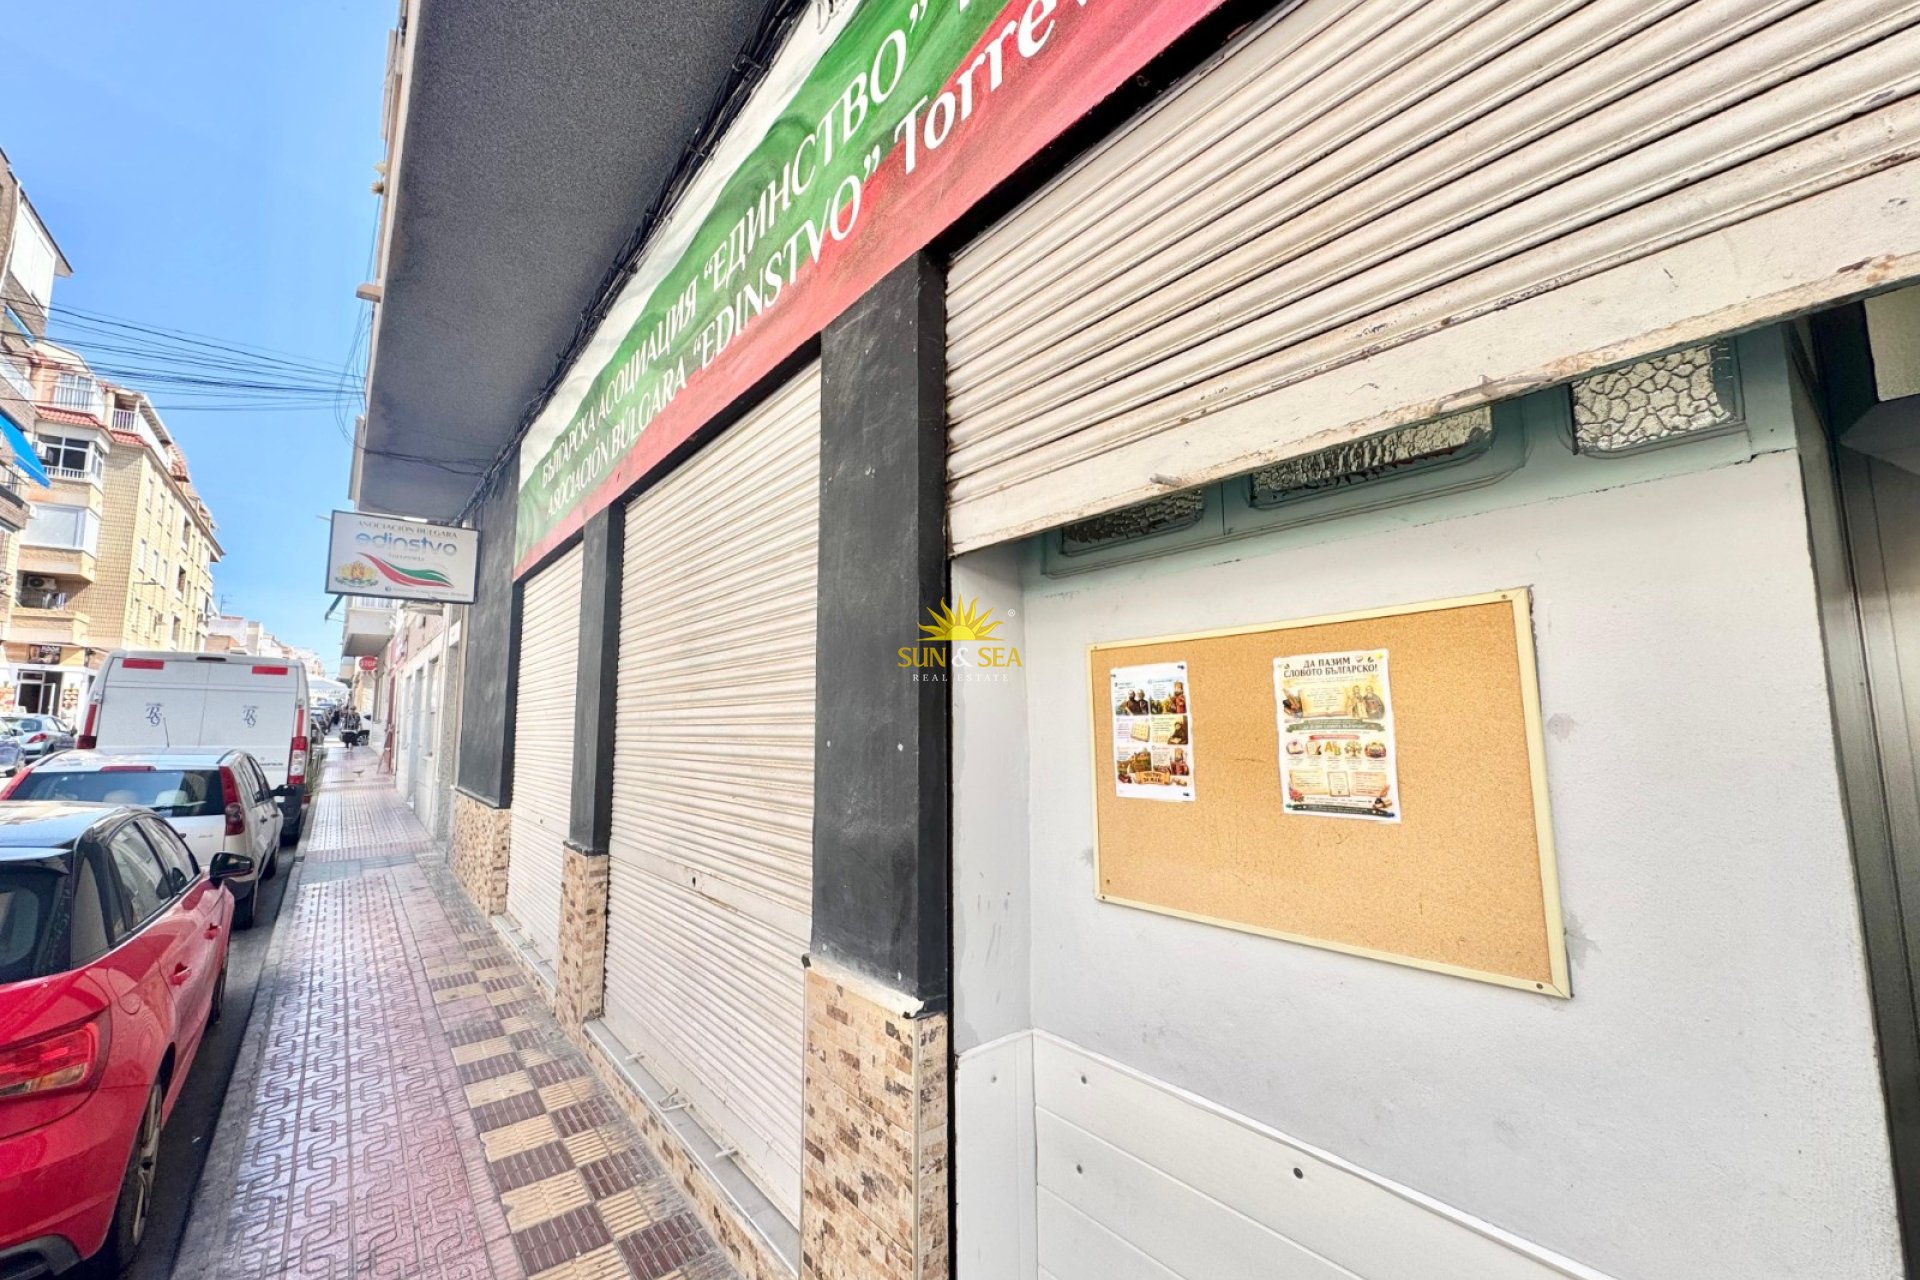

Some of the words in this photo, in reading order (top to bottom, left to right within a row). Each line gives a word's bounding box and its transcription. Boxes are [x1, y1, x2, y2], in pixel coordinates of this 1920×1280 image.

[546, 430, 610, 520] ASOCIACIÓN
[894, 0, 1087, 175] Torre
[542, 413, 596, 488] БЪЛГАРСКА
[595, 275, 700, 430] АСОЦИАЦИЯ
[356, 532, 457, 556] edinstvo
[1284, 668, 1323, 678] СЛОВОТО
[1303, 659, 1316, 669] ДА
[1318, 657, 1351, 667] ПАЗИМ
